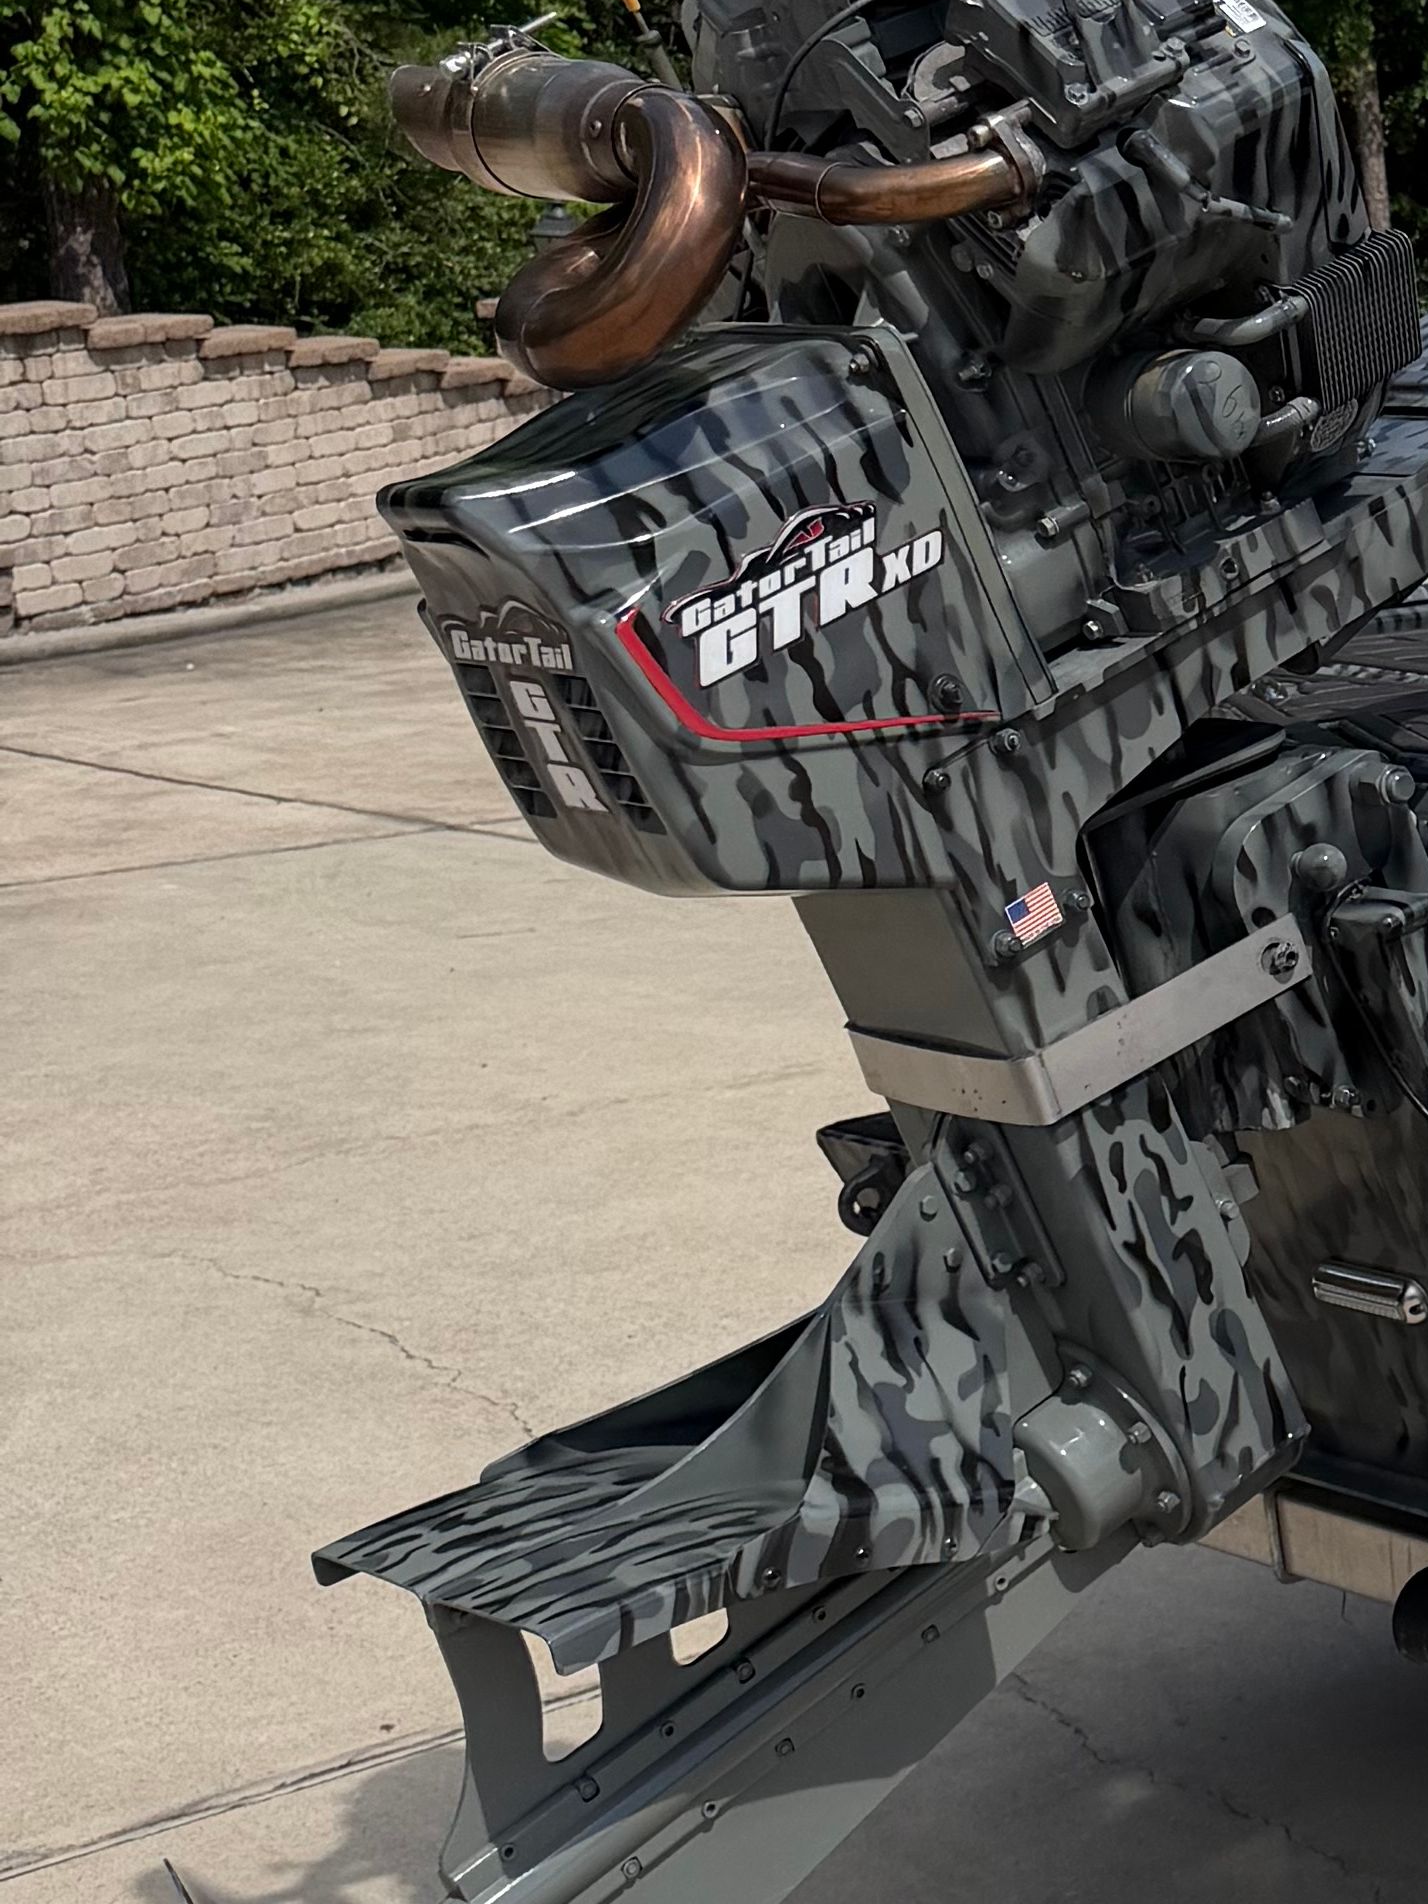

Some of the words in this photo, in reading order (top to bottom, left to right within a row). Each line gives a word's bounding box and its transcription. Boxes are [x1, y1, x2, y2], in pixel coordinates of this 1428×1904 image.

[680, 516, 876, 638] GatorTail
[698, 547, 878, 688] GTR
[880, 528, 944, 594] XD
[450, 629, 574, 671] GatorTail
[508, 679, 610, 813] GTR
